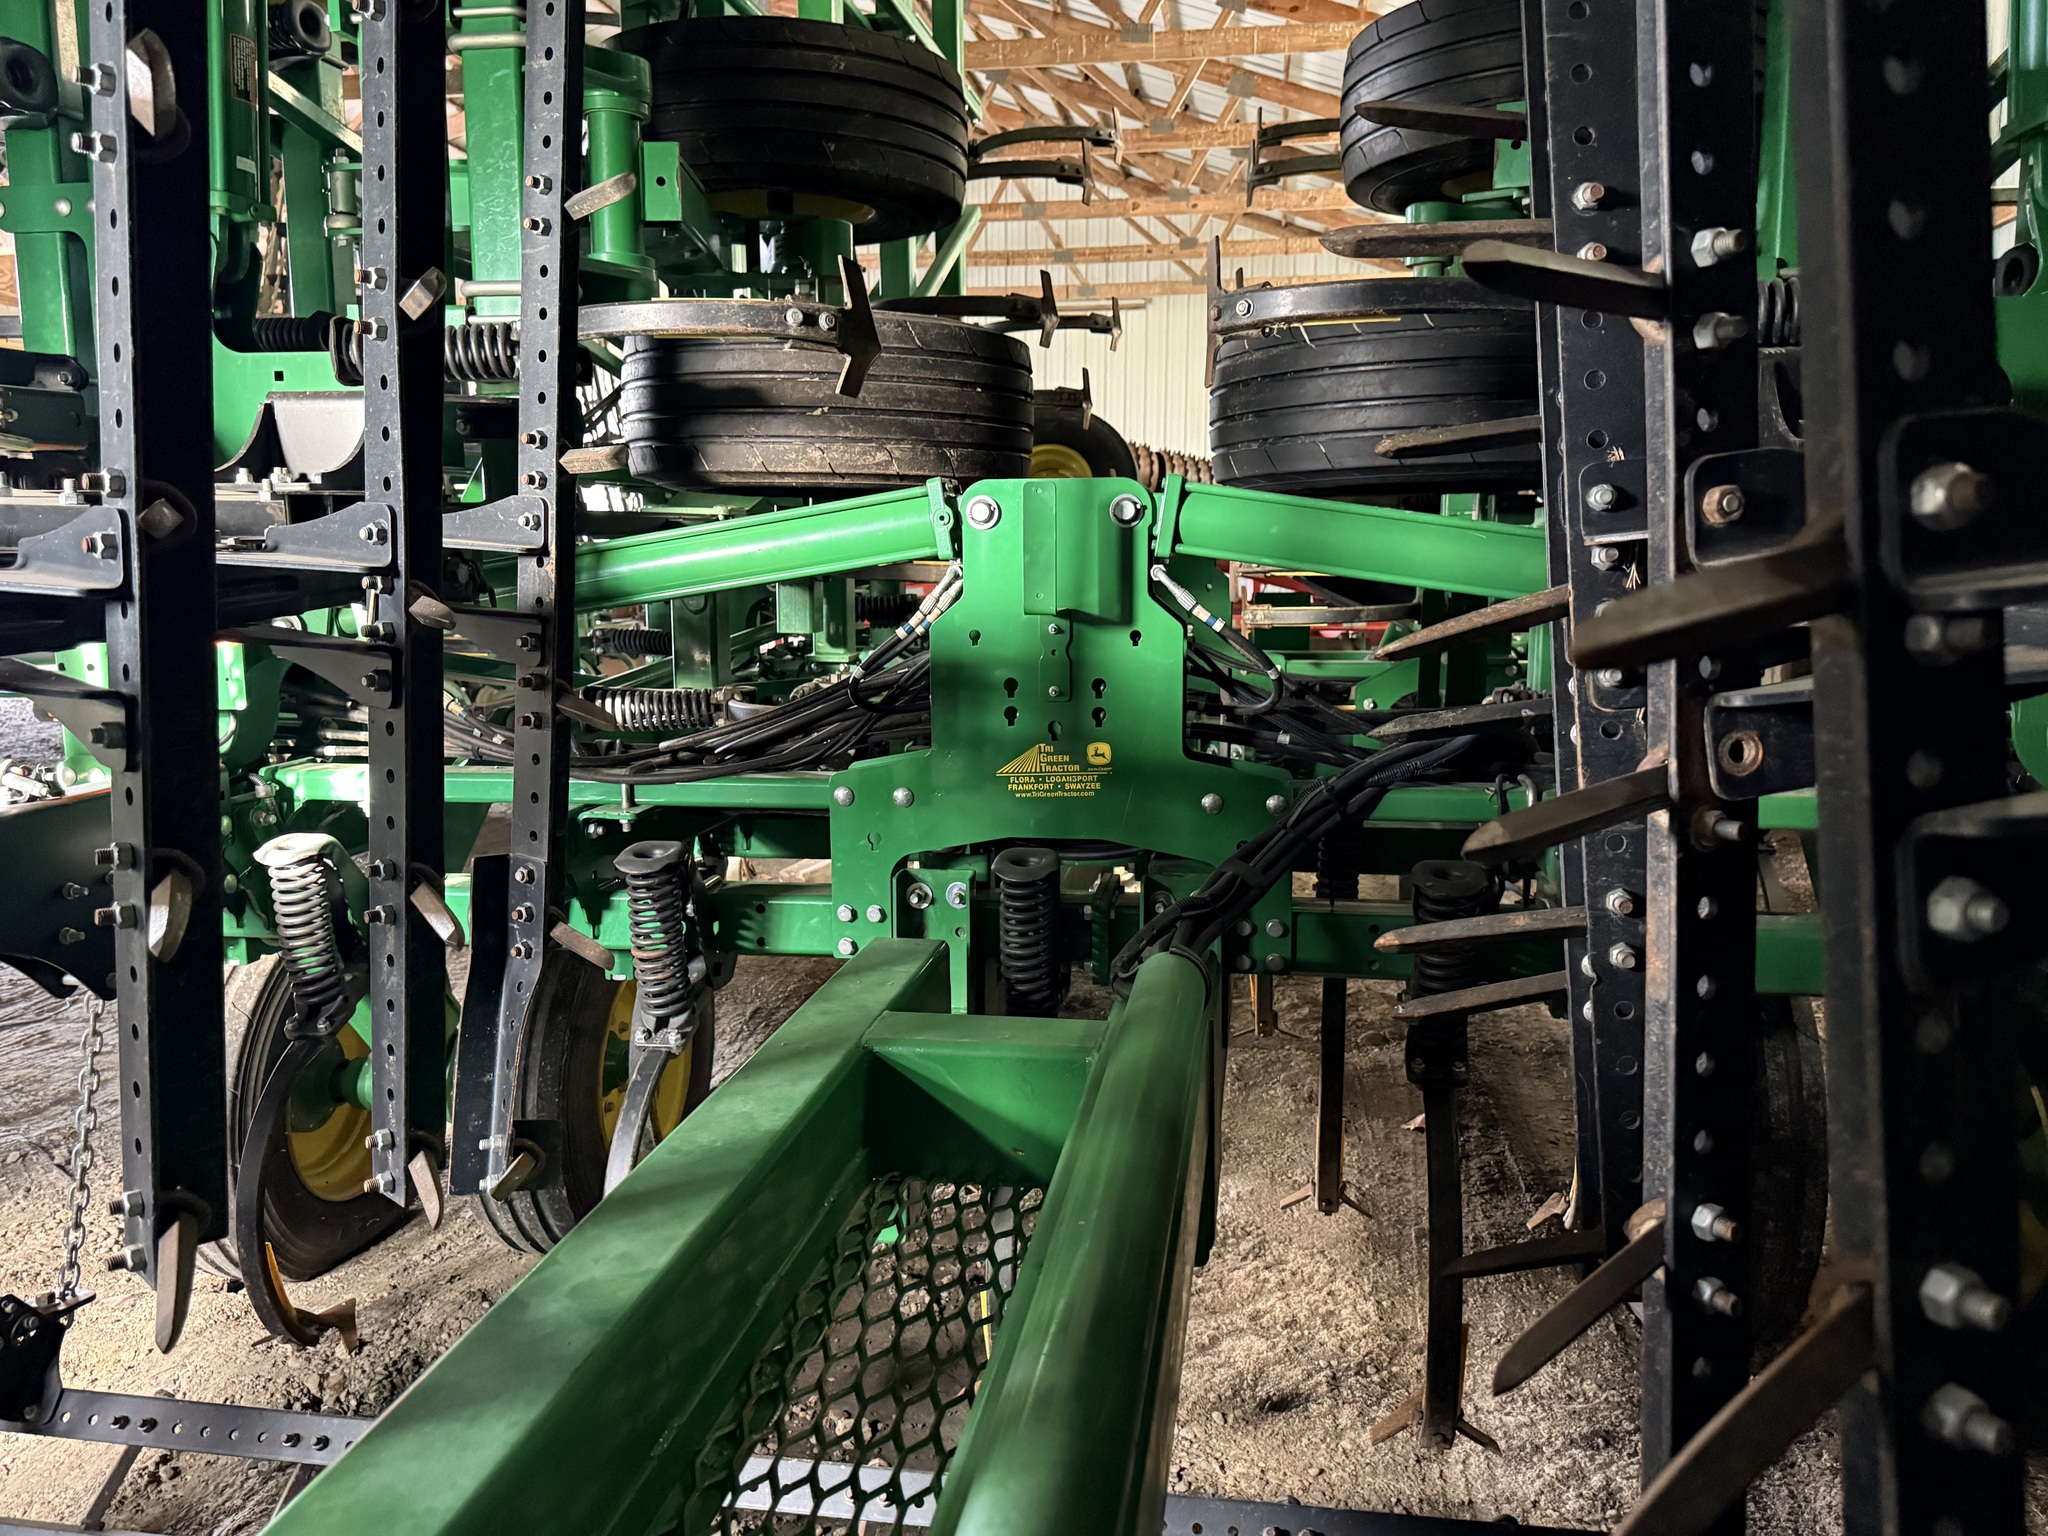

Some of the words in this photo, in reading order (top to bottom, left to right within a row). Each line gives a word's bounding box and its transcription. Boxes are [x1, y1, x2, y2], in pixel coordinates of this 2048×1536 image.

[1010, 776, 1036, 784] FLORA
[1045, 775, 1098, 783] LOGANSPORT
[1008, 783, 1054, 791] FRANKFORT
[1065, 782, 1101, 790] SWAYZEE
